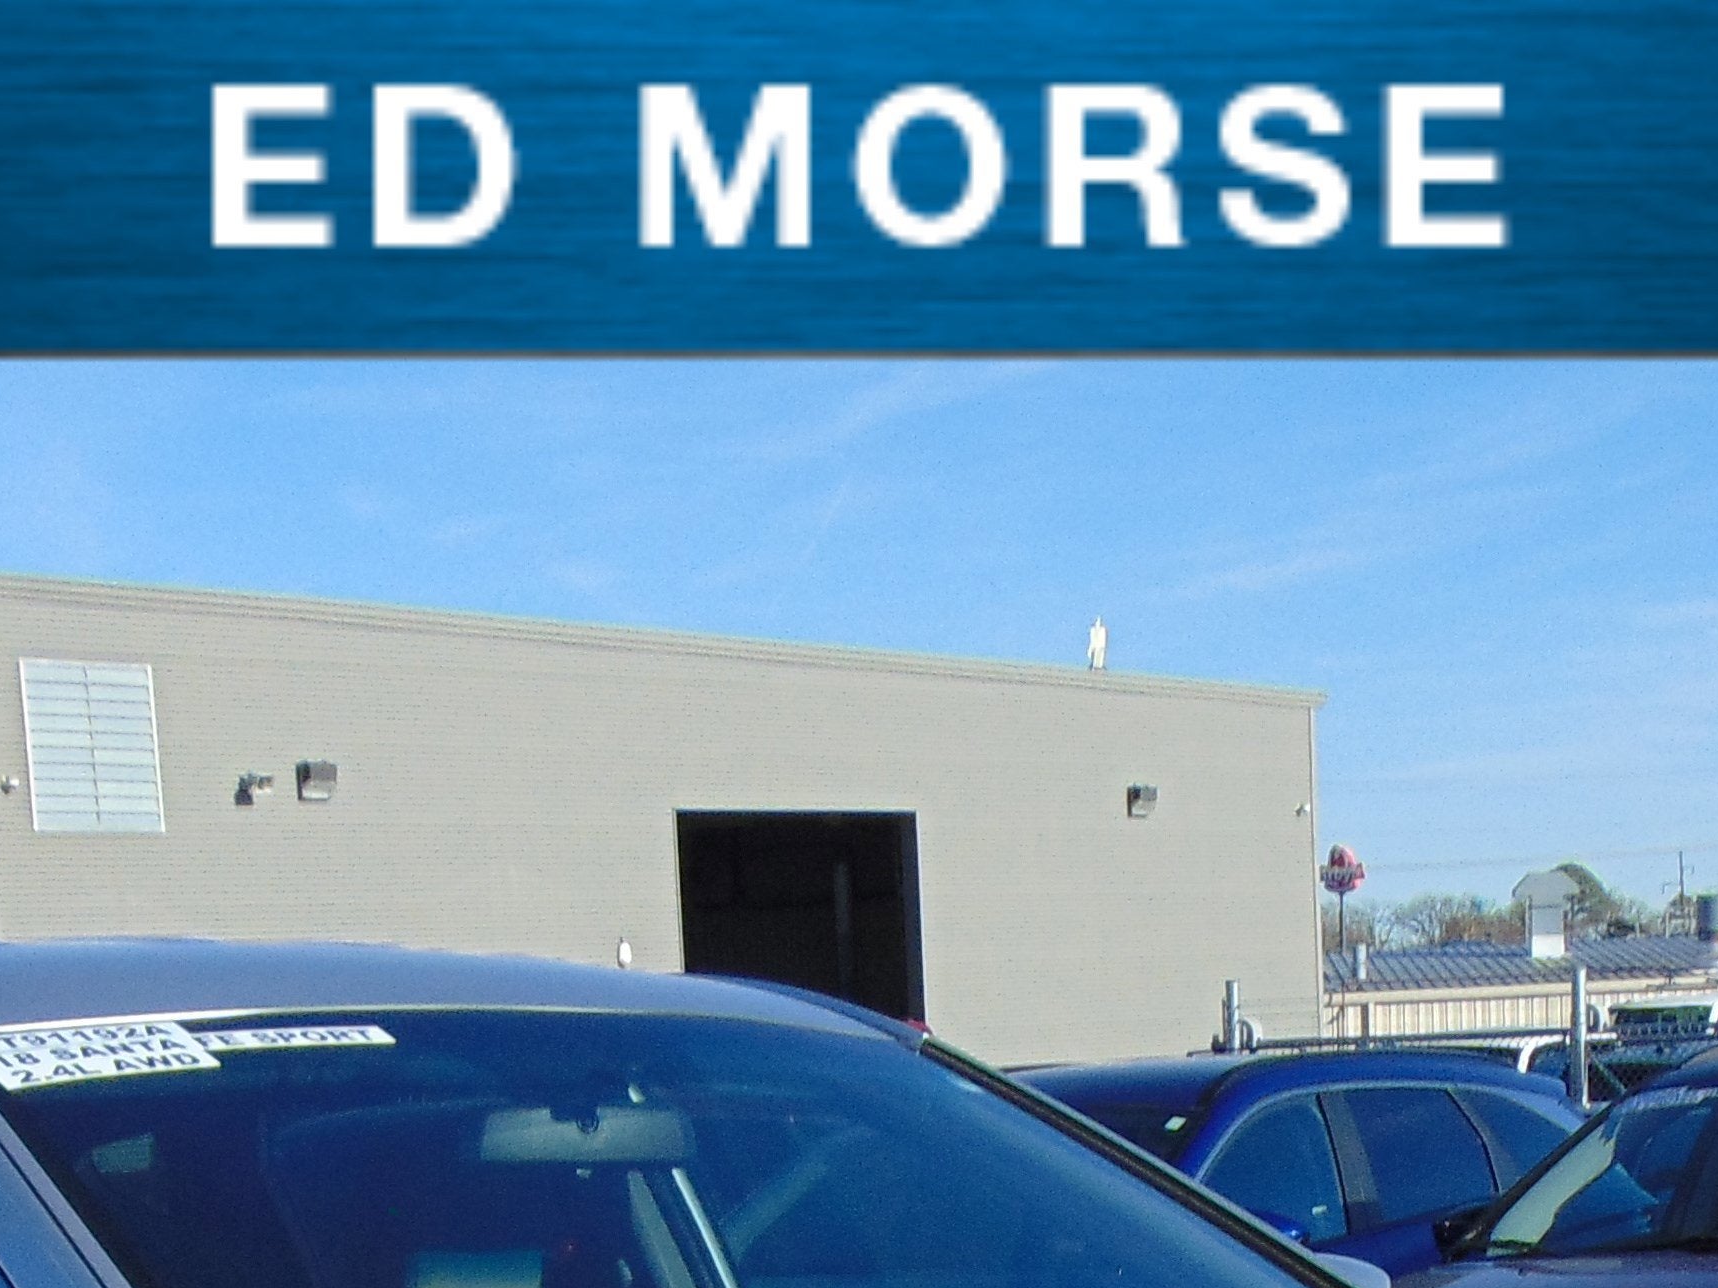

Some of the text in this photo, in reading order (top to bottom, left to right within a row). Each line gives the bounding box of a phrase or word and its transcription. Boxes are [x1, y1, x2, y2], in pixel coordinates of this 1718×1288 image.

[49, 1037, 187, 1060] SANTA
[192, 1033, 239, 1048] FE
[250, 1028, 373, 1044] SPORT
[11, 1052, 201, 1083] 2.4L AWD
